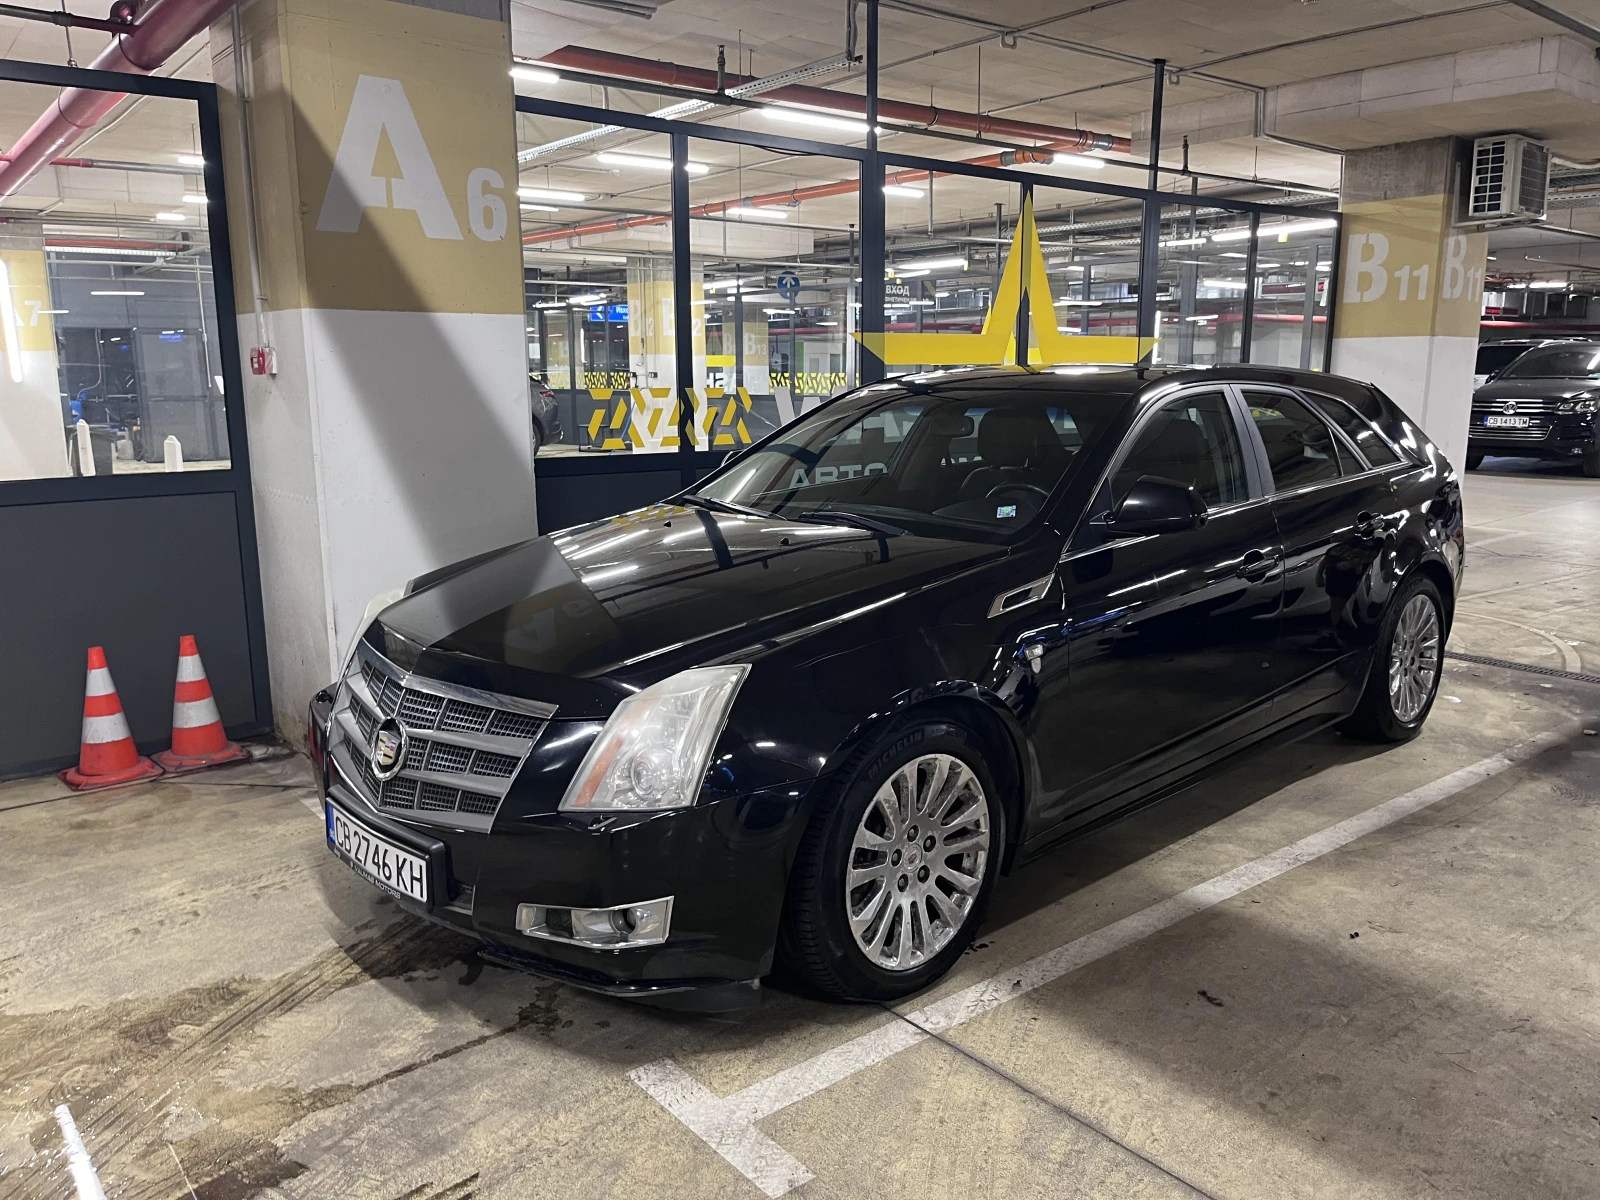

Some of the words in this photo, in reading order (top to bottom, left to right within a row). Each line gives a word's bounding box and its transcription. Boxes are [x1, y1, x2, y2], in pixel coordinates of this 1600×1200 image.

[1343, 233, 1429, 303] B11
[1442, 228, 1482, 302] B11
[885, 285, 910, 296] ВХОД
[743, 332, 767, 355] B13
[867, 729, 923, 779] MICHELIN
[336, 816, 351, 854] CB
[354, 830, 392, 881] 2746
[396, 854, 424, 899] KH
[375, 878, 401, 900] MOTORS
